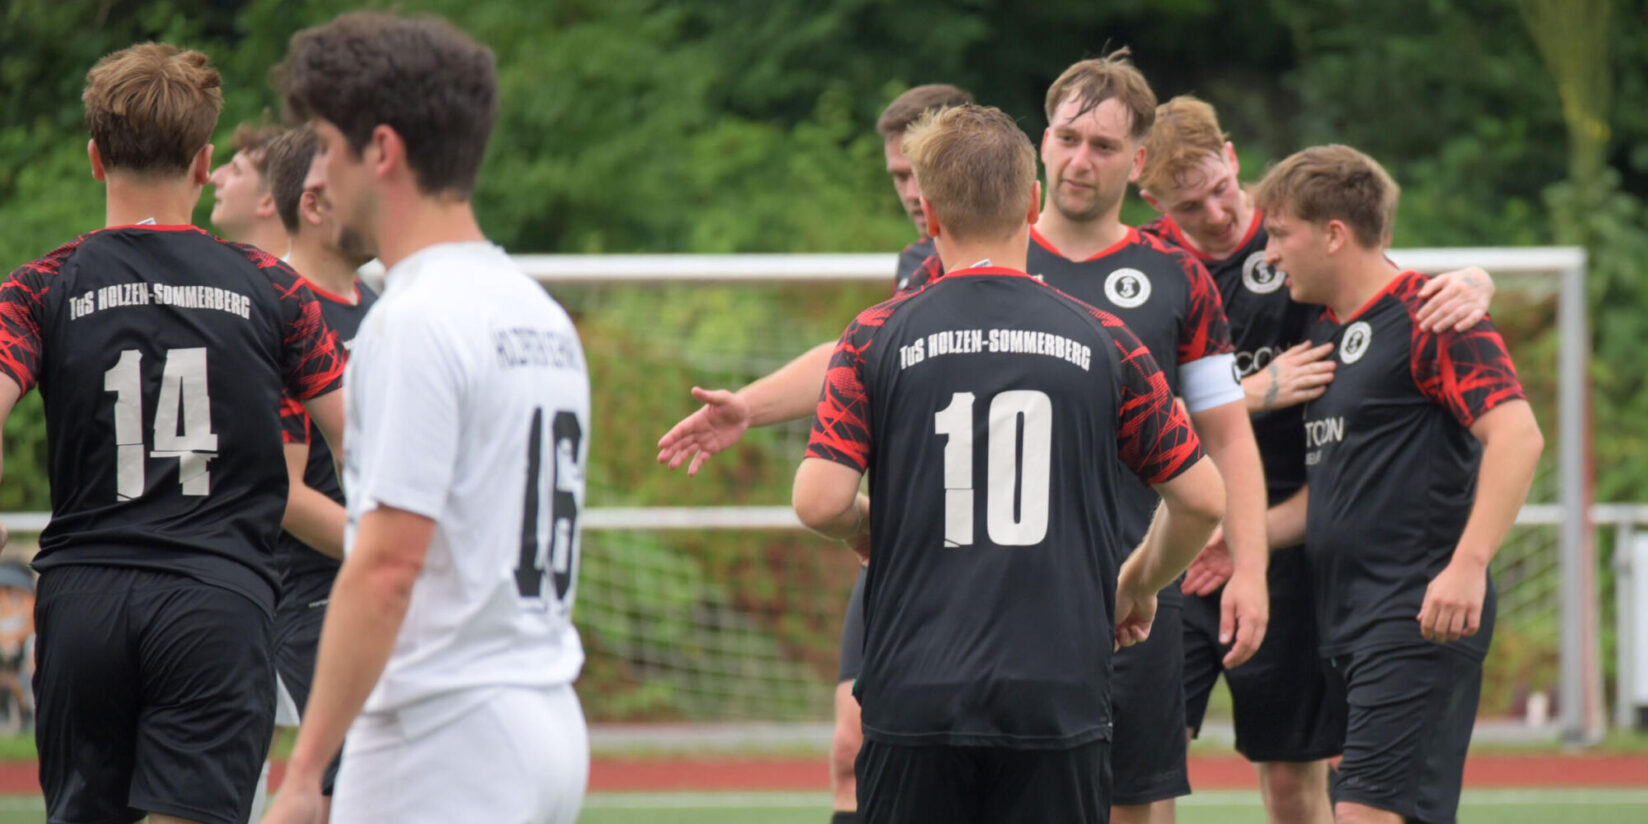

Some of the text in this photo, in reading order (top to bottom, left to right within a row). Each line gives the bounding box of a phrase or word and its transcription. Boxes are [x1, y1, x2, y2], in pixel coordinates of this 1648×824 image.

[69, 282, 251, 321] TuS HOLZEN-SOMMERBERG
[899, 328, 1092, 372] TuS HOLZEN-SOMMERBERG
[104, 347, 219, 502] 14
[934, 389, 1053, 548] 10
[514, 405, 582, 601] 16
